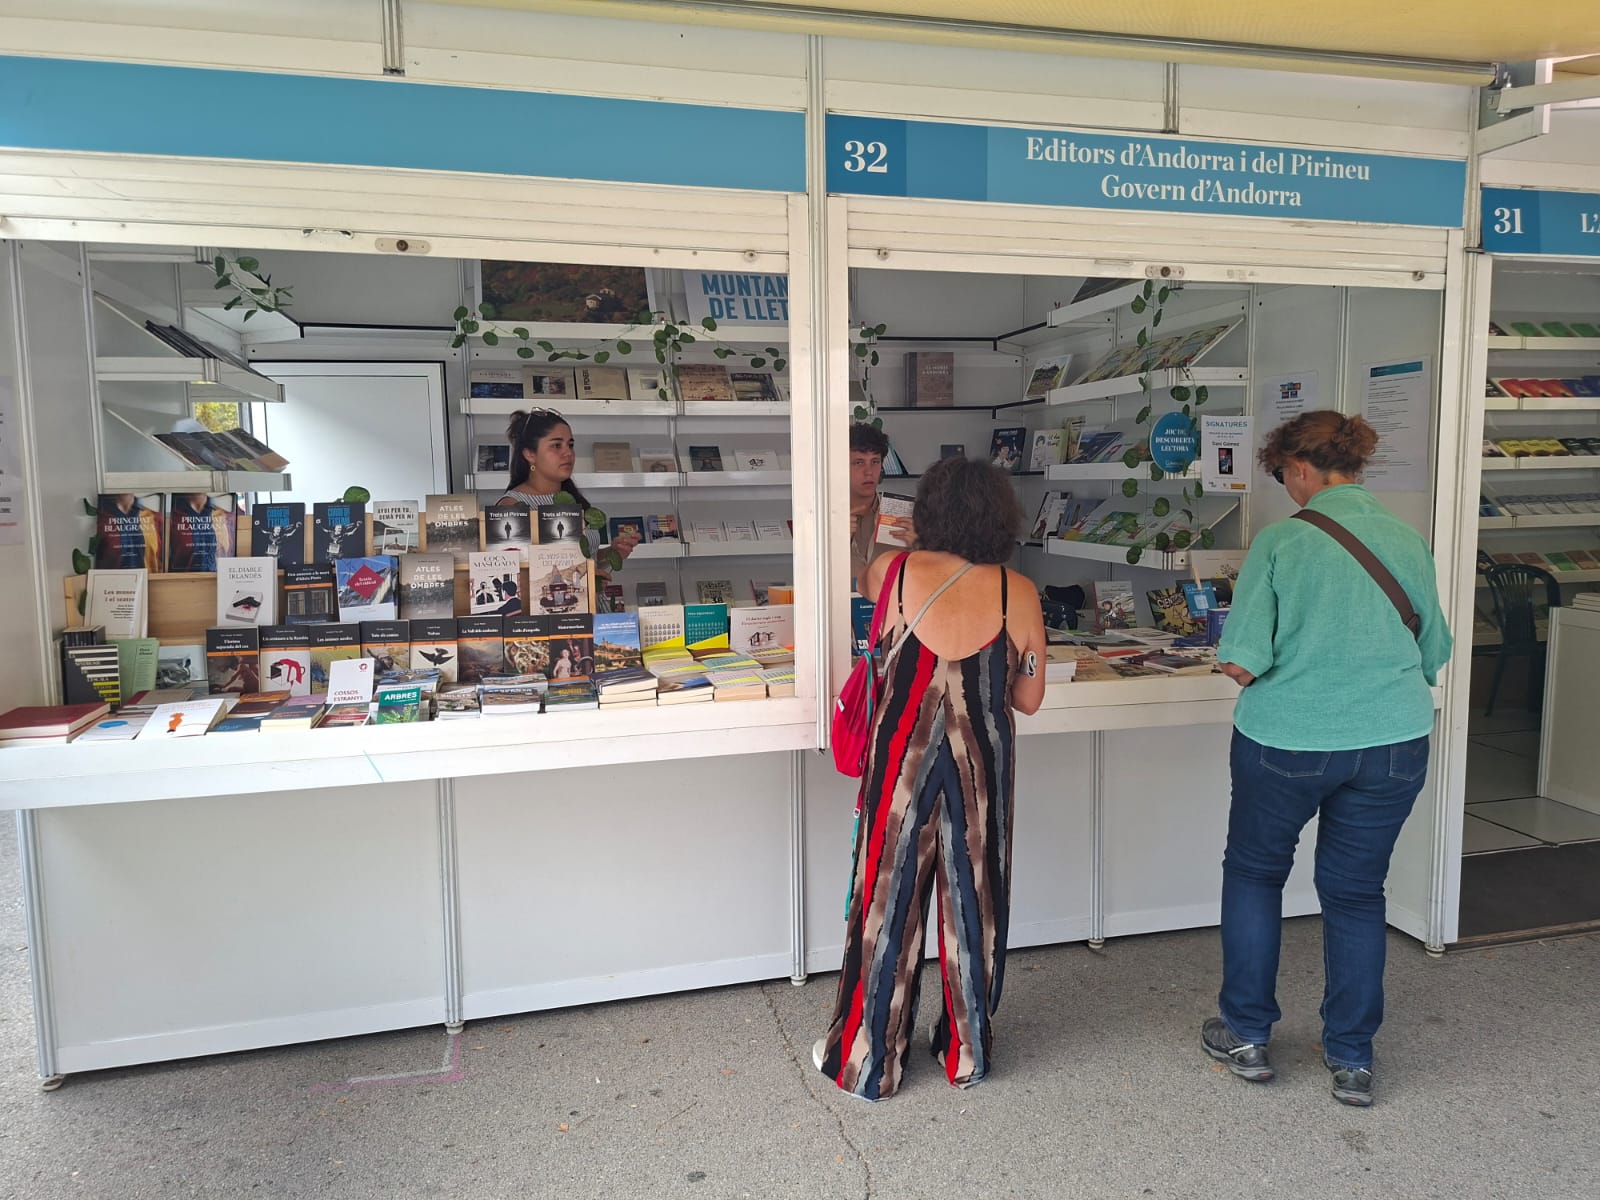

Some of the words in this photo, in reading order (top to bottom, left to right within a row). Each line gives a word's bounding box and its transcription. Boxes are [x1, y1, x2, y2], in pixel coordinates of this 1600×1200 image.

[844, 140, 889, 173] 32
[1025, 136, 1115, 167] Editors
[1120, 143, 1235, 173] d'Andorra
[1240, 150, 1248, 173] i
[1251, 152, 1284, 176] del
[1291, 153, 1371, 182] Pirineu
[1100, 174, 1185, 201] Govern
[1190, 179, 1302, 208] d'Andorra
[1493, 206, 1524, 235] 31
[709, 297, 739, 320] DE
[385, 692, 419, 702] ARBRES
